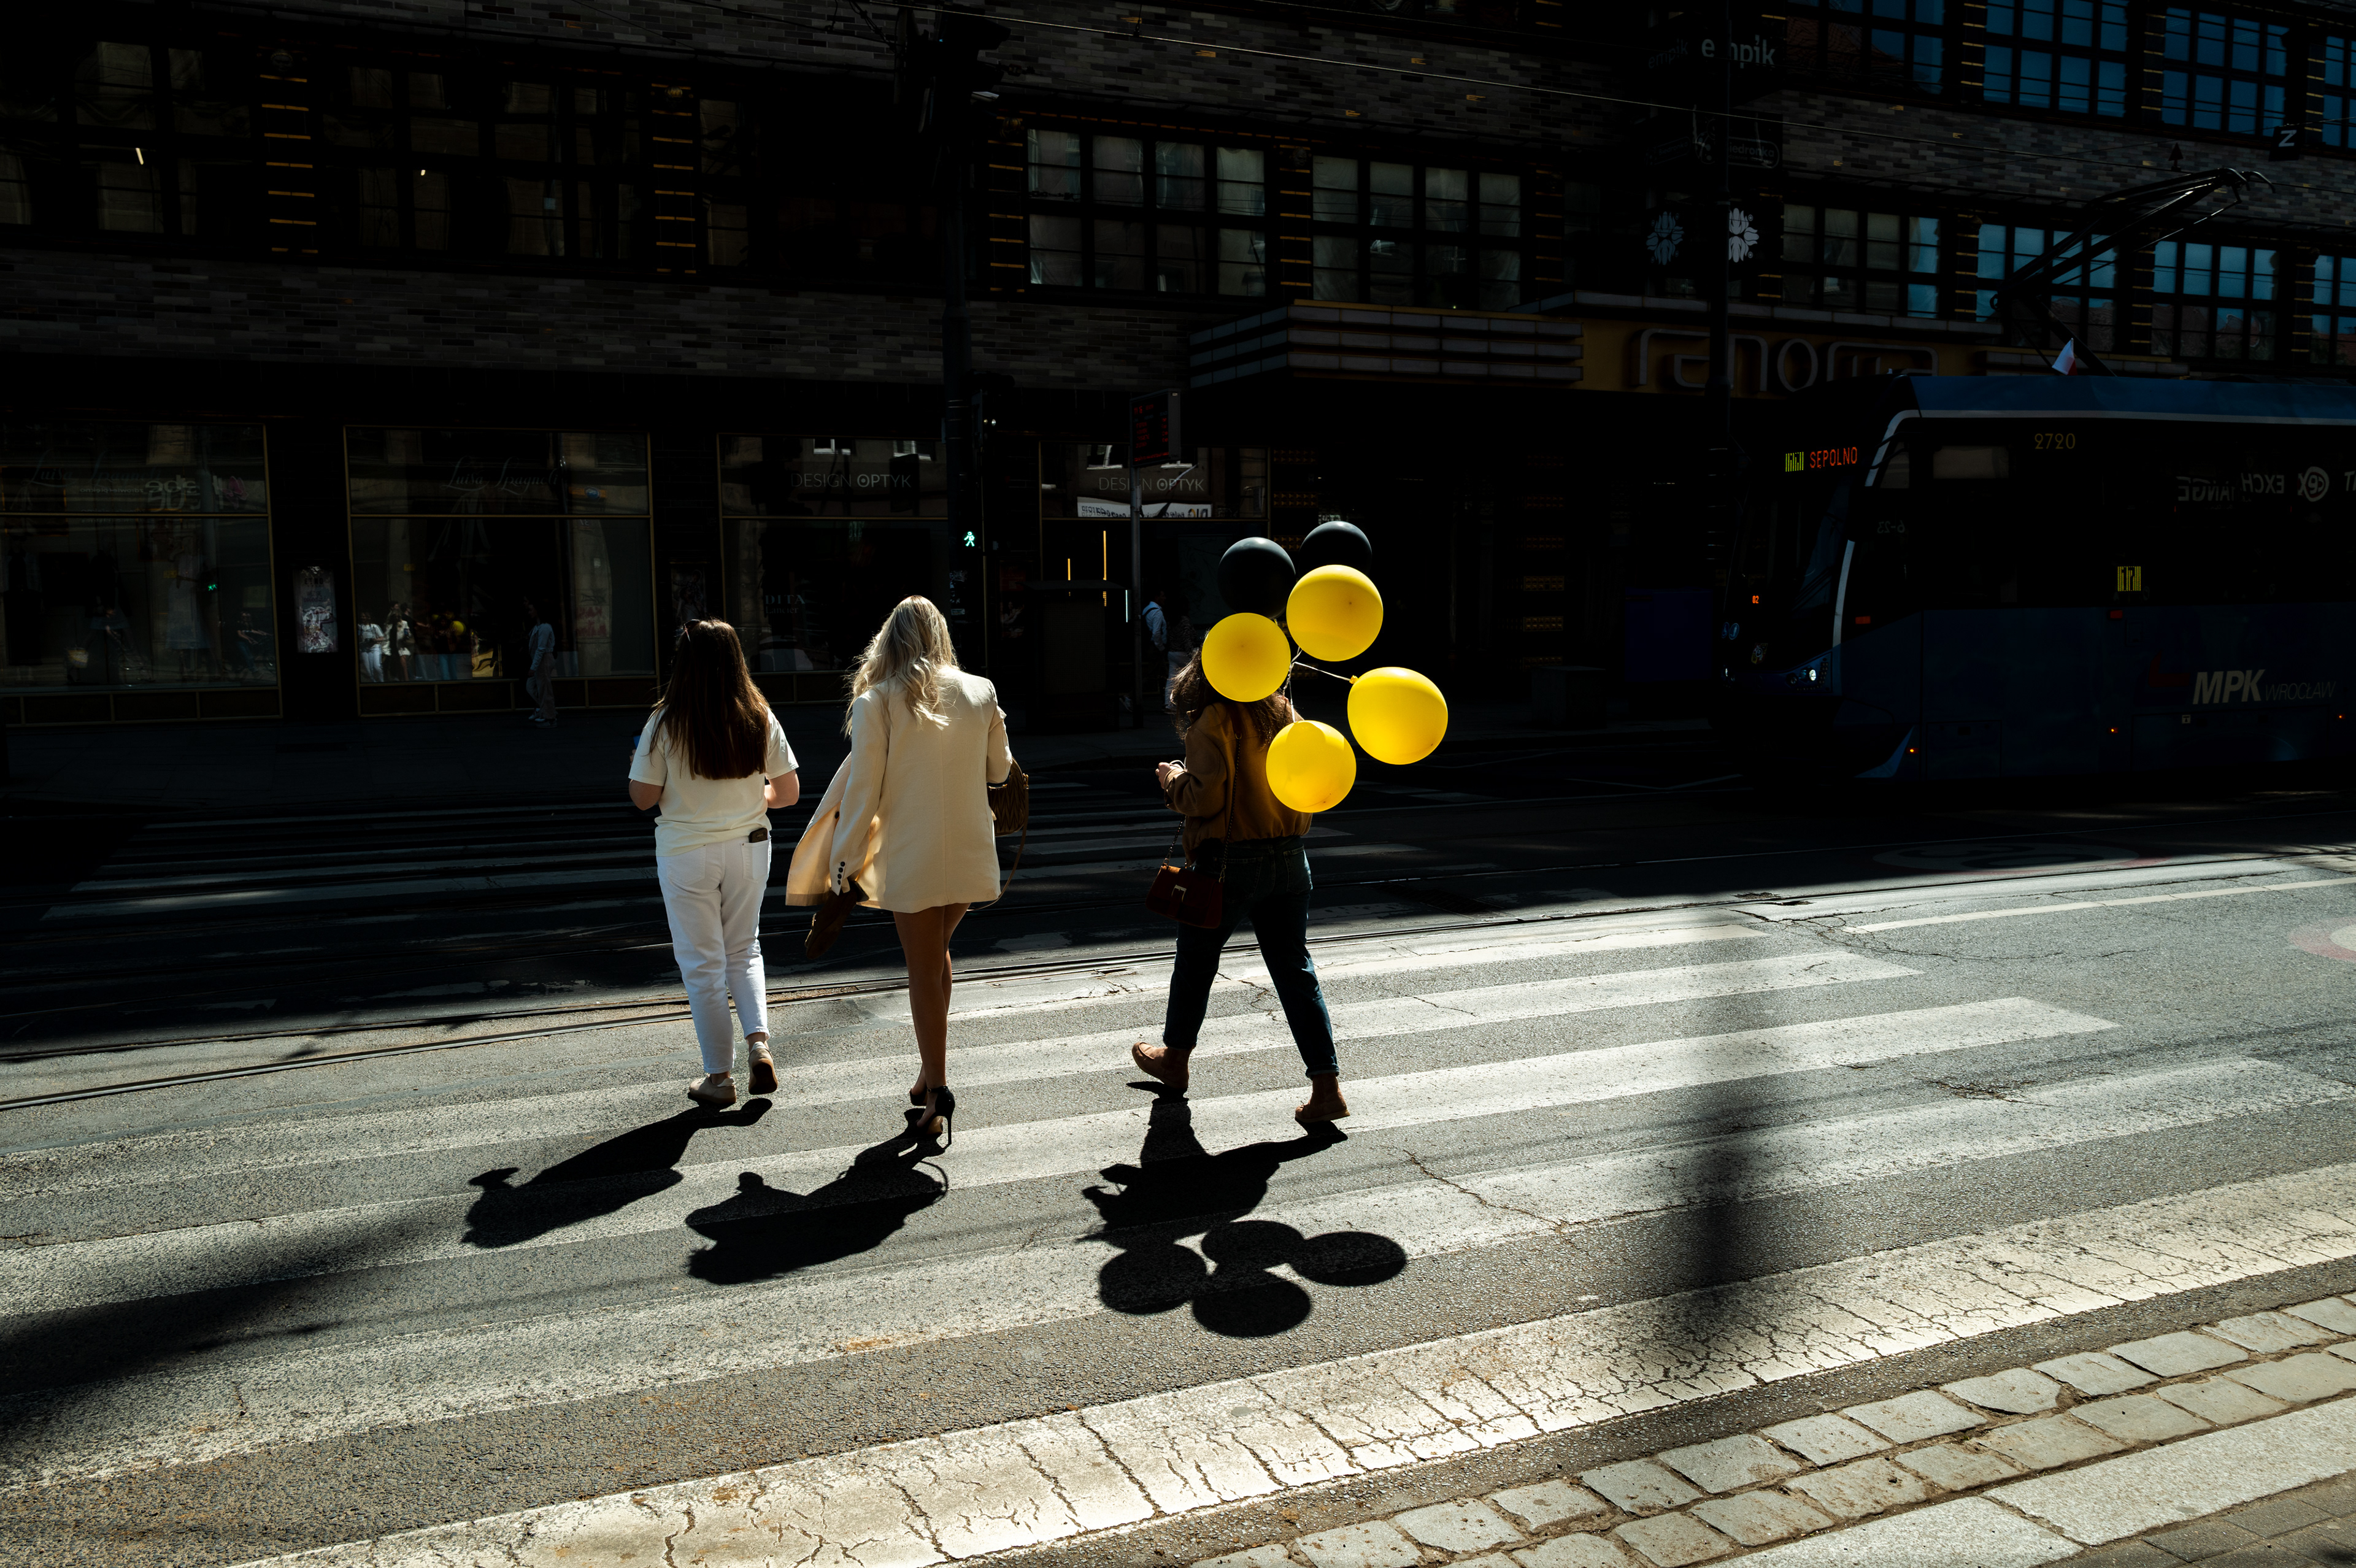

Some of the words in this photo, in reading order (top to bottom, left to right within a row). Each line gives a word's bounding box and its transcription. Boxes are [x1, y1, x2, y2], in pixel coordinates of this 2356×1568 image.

[2277, 129, 2297, 147] Z
[1728, 142, 1774, 157] iedronka
[2033, 432, 2076, 450] 2720
[1809, 447, 1858, 469] SĘPOLNO
[790, 473, 852, 488] DESIGN
[857, 474, 912, 488] OPTYK
[1099, 477, 1152, 491] DESIN
[1156, 478, 1205, 491] OPTYK
[2120, 566, 2138, 591] 17
[765, 594, 806, 604] DITA
[2192, 669, 2266, 705] MPK
[2265, 681, 2336, 702] WROCŁAW
